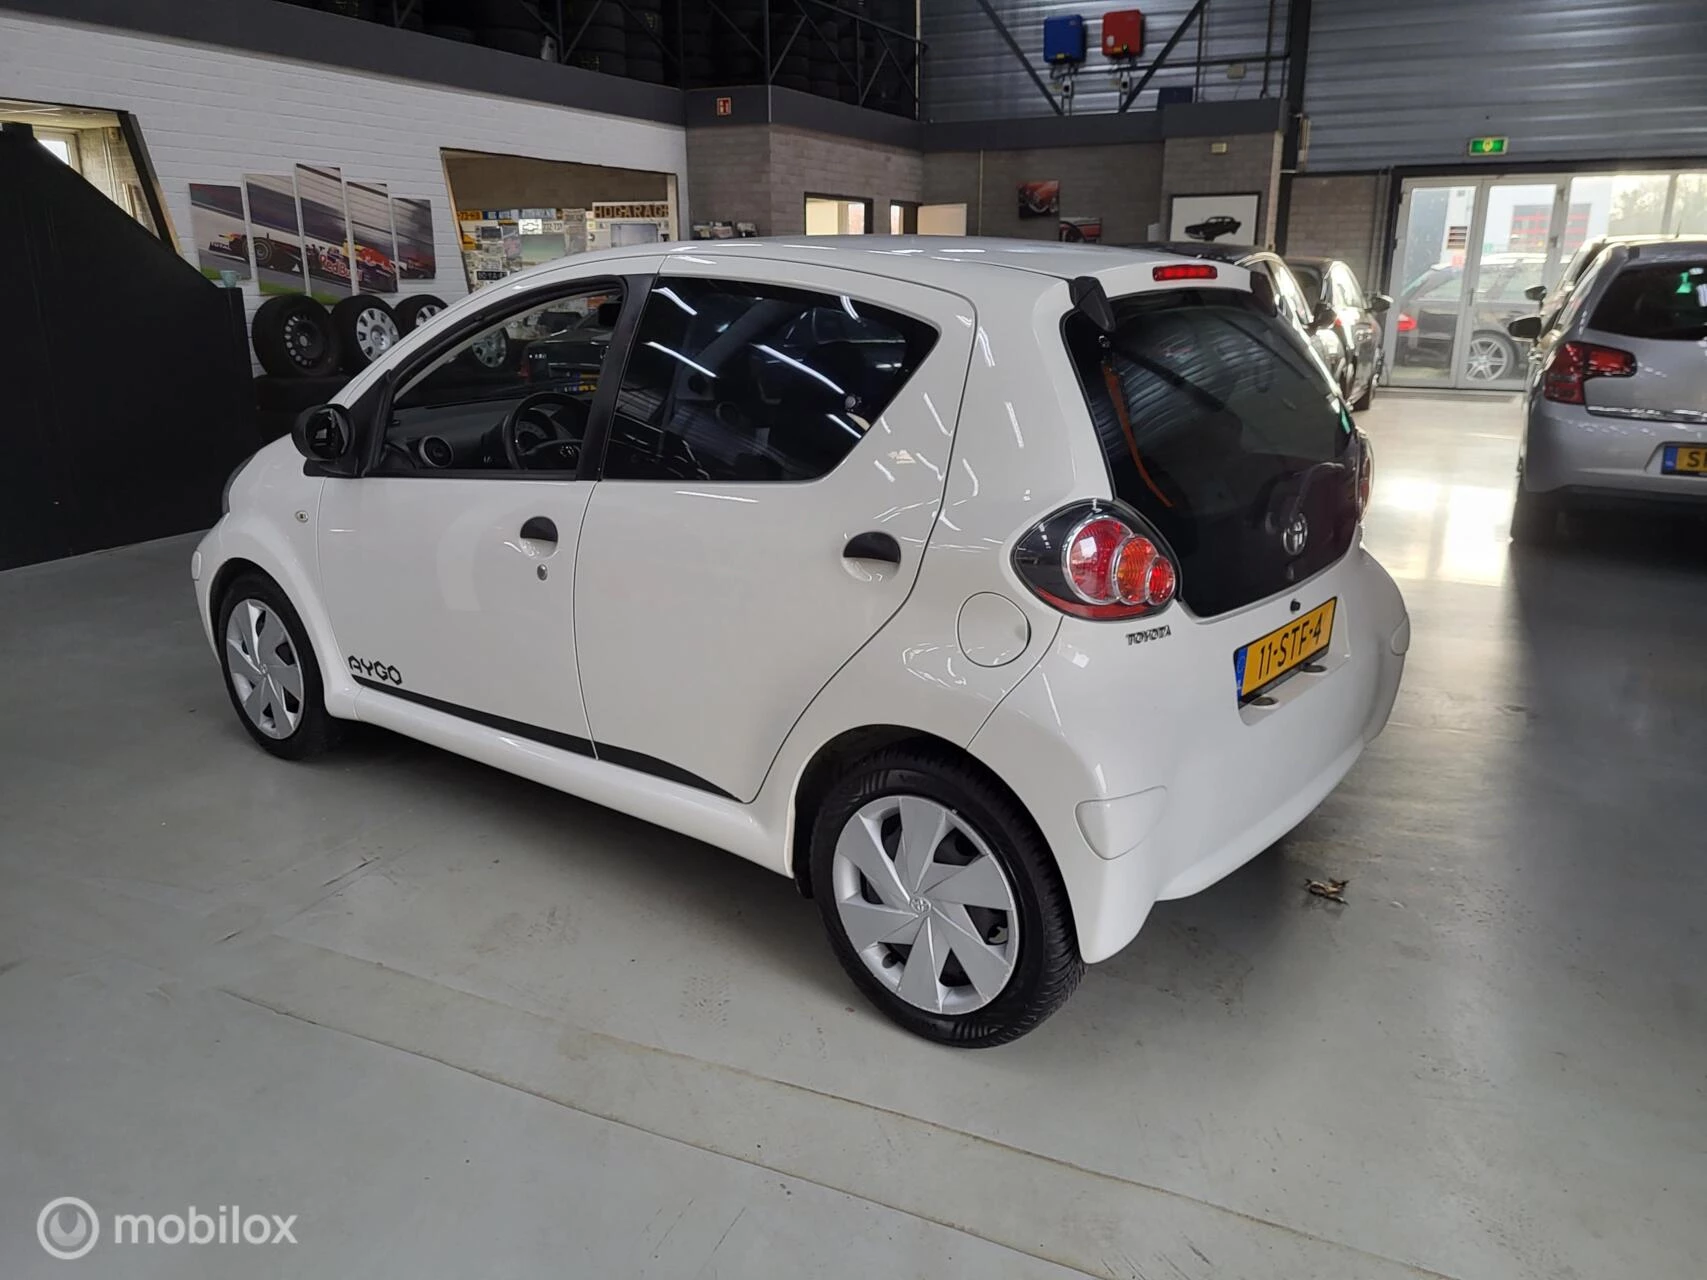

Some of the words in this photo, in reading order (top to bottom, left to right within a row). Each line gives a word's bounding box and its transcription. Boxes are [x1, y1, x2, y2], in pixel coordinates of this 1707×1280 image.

[1126, 625, 1171, 645] TOYOTA
[1258, 613, 1322, 681] 11-STF-4
[348, 655, 402, 685] AYGO
